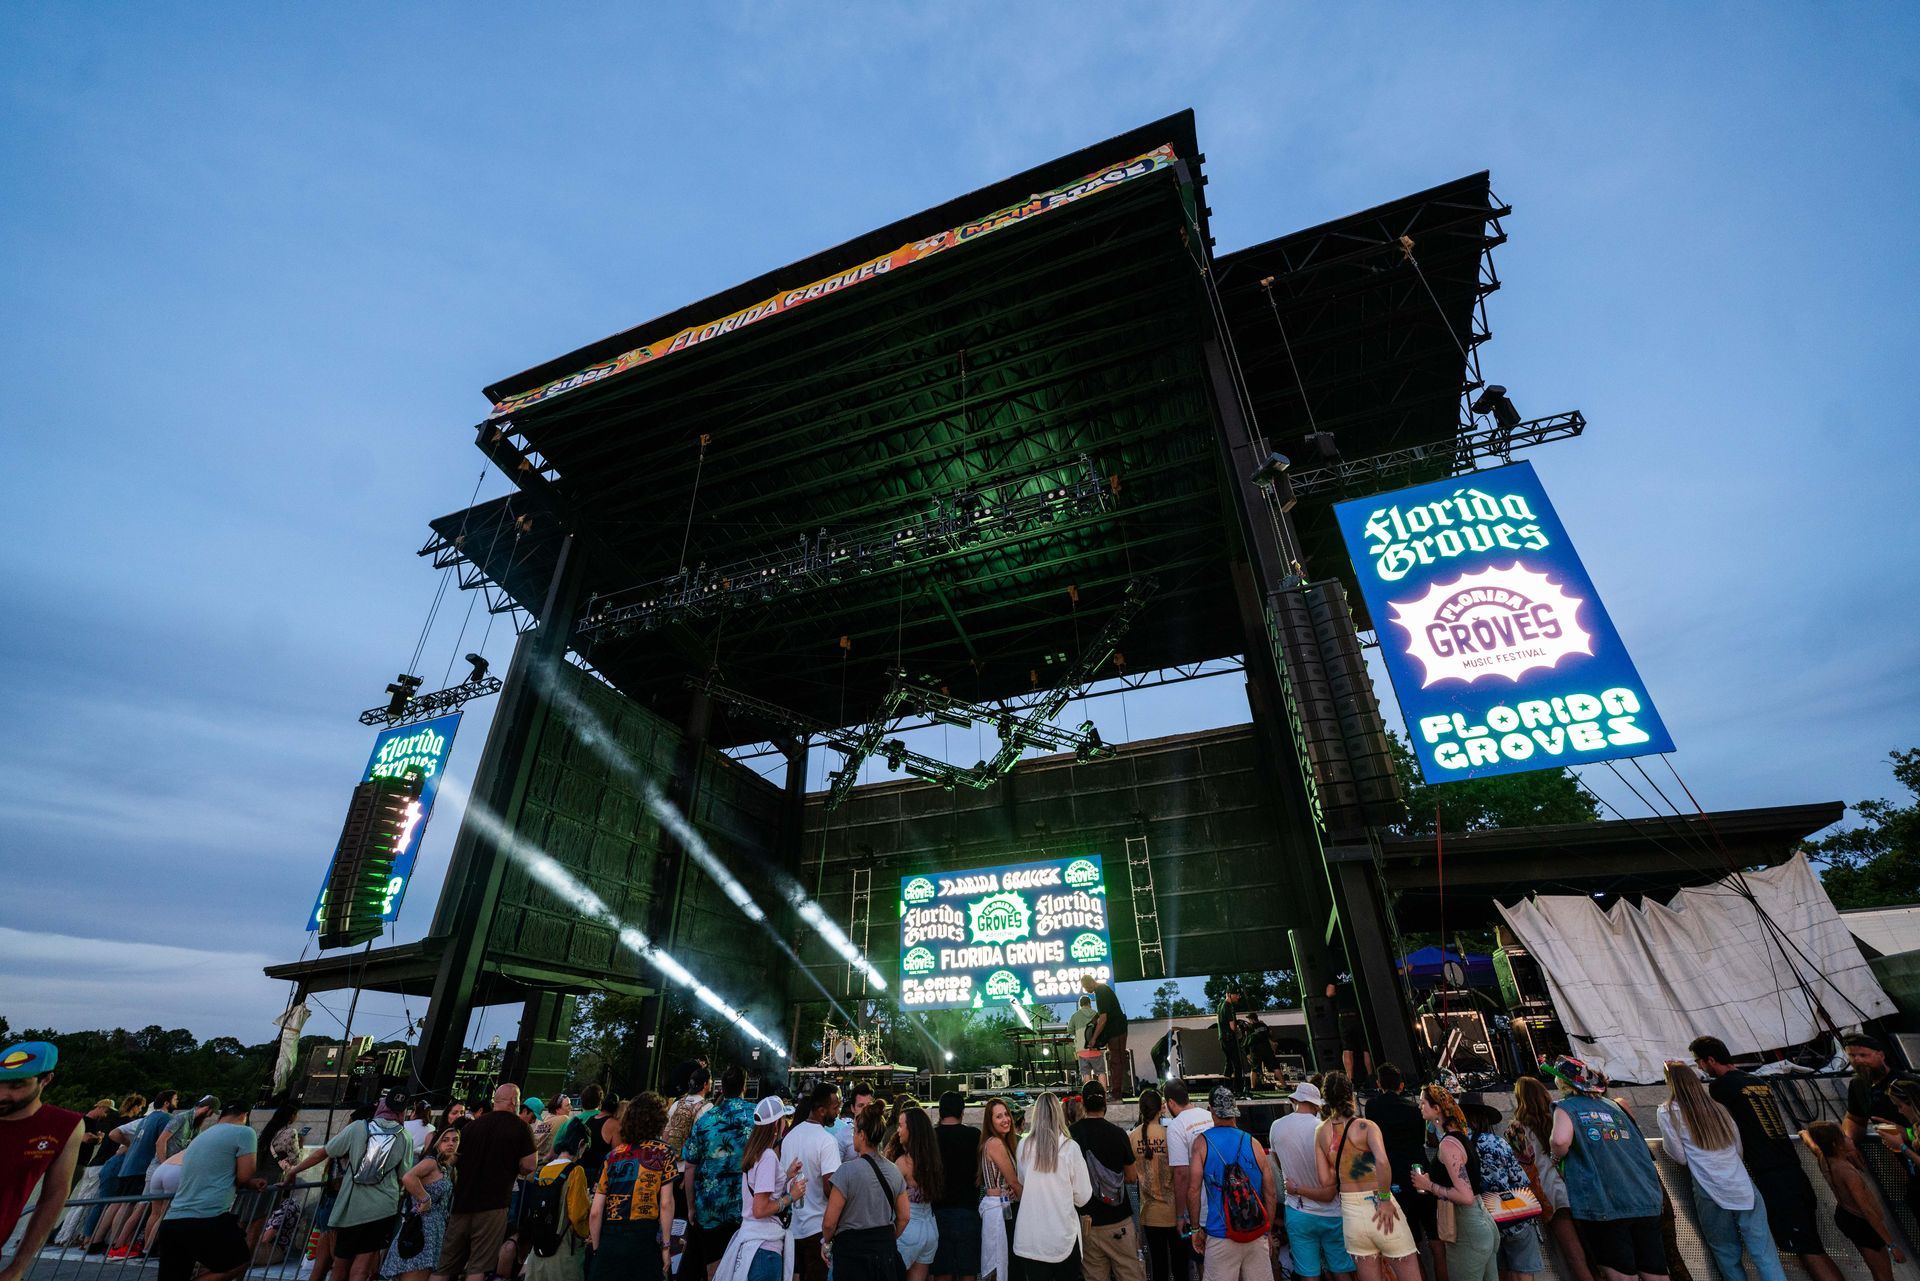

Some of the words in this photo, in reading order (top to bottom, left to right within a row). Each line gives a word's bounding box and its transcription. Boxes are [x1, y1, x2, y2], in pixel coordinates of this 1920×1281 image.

[1049, 163, 1147, 208] STAGE
[667, 300, 778, 353] FLORIDA
[784, 257, 892, 307] GROVES
[1364, 488, 1537, 547] Florida
[1369, 521, 1550, 582] Groves
[1440, 589, 1523, 621] FLORIDA
[1425, 603, 1563, 658] GROVES
[1462, 656, 1494, 669] MUSIC
[1496, 647, 1548, 662] FESTIVAL
[1419, 687, 1641, 744] FLORIDA
[377, 728, 445, 764] Florida
[1434, 715, 1650, 770] GROVES
[1064, 868, 1099, 884] GROVES
[904, 886, 935, 901] GROVES
[1035, 891, 1103, 916] Florida
[904, 904, 964, 927] Florida
[977, 911, 1022, 932] GROVES
[1035, 911, 1105, 936] Groves
[904, 923, 965, 947] Groves
[941, 945, 1004, 970] FLORIDA
[1006, 940, 1064, 965] GROVES
[1070, 941, 1107, 959] GROVES
[903, 955, 935, 971] GROVES
[902, 975, 972, 993] FLORIDA
[1033, 966, 1110, 984] FLORIDA
[903, 988, 971, 1005] GROVES
[986, 979, 1020, 995] GROVES
[1136, 1146, 1167, 1154] CHNCE
[1137, 1138, 1165, 1147] MLKY
